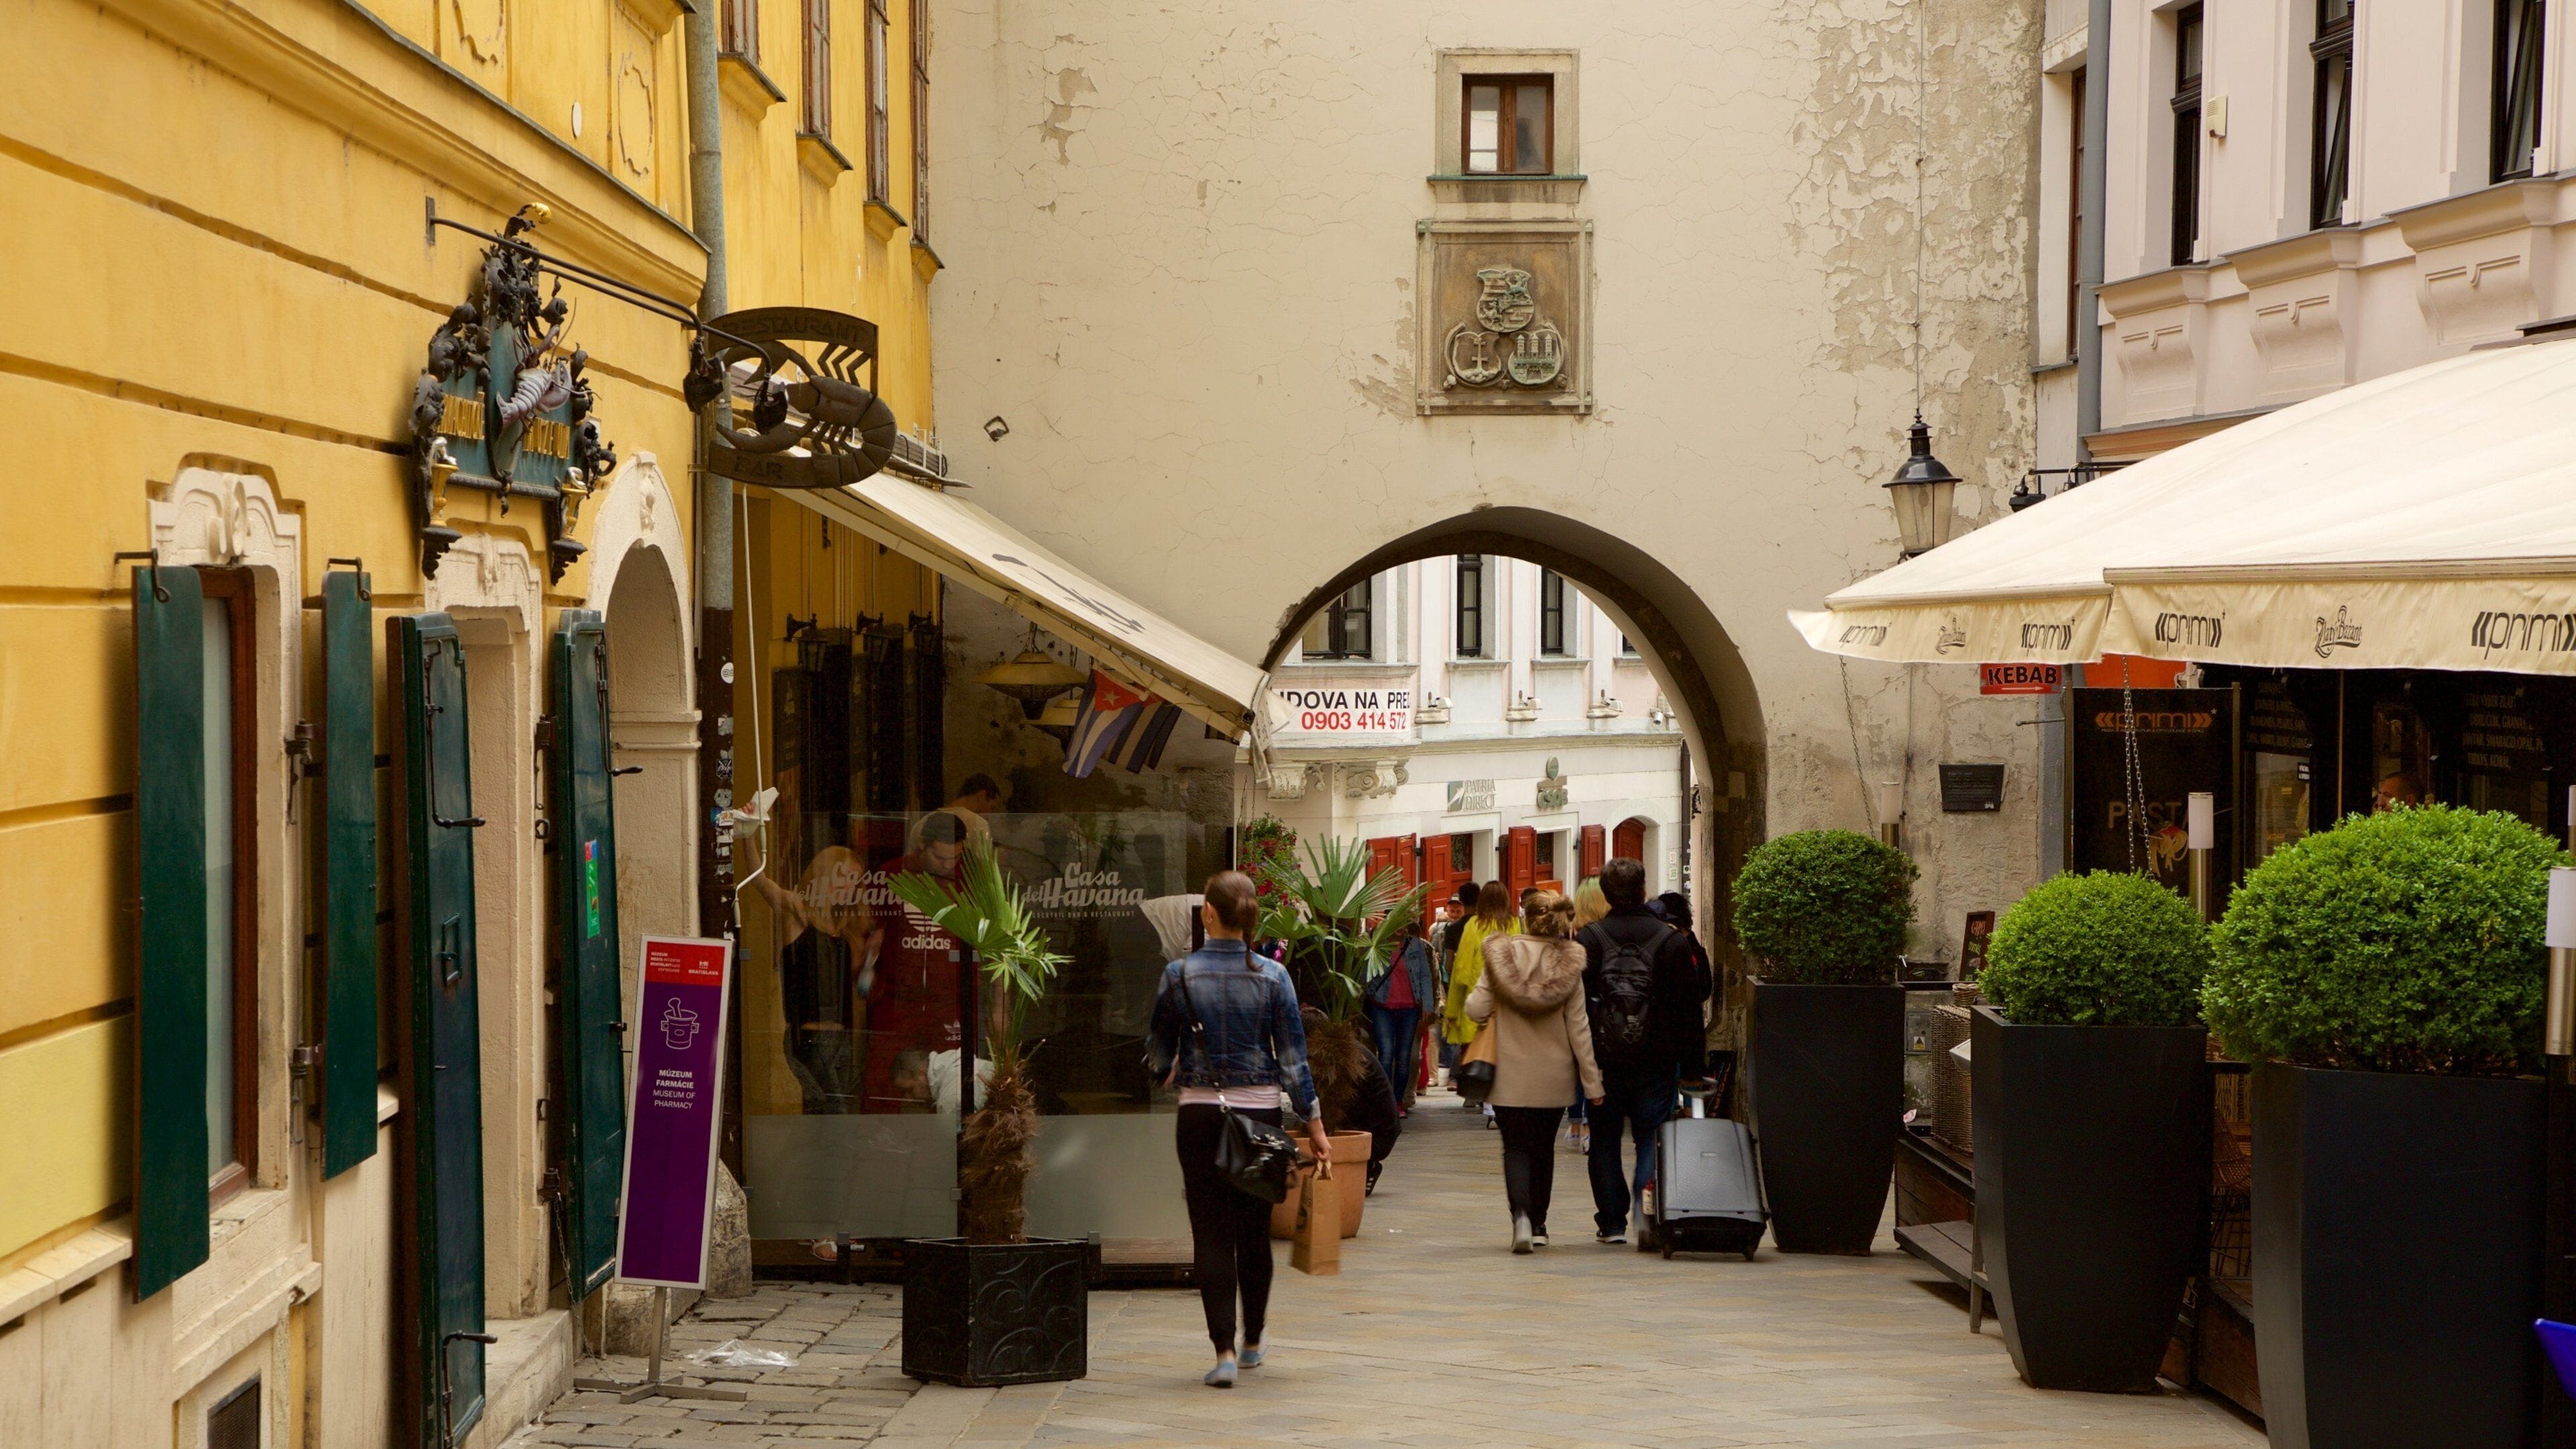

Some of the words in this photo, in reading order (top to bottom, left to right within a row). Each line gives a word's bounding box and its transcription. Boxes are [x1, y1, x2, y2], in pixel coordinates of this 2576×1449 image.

[733, 455, 784, 479] BAR
[2167, 612, 2211, 652] primi
[2483, 612, 2562, 661] primi
[1988, 666, 2058, 686] KEBAB
[1354, 692, 1379, 709] NA
[1301, 711, 1352, 730] 0903
[1357, 712, 1386, 730] 414
[1389, 712, 1406, 730] 572
[1464, 779, 1495, 793] PATRIA
[1464, 794, 1495, 810] DIRECT
[2108, 801, 2188, 829] PAST
[831, 861, 887, 887] Casa
[1064, 861, 1121, 888] Casa
[1022, 885, 1044, 903] del
[1042, 877, 1146, 908] Havana
[902, 934, 951, 950] adidas
[659, 1068, 693, 1079] MÚZEUM
[653, 1089, 685, 1098] MUSEUM
[655, 1079, 694, 1089] FARMÁCIE
[654, 1099, 693, 1109] PHARMACY
